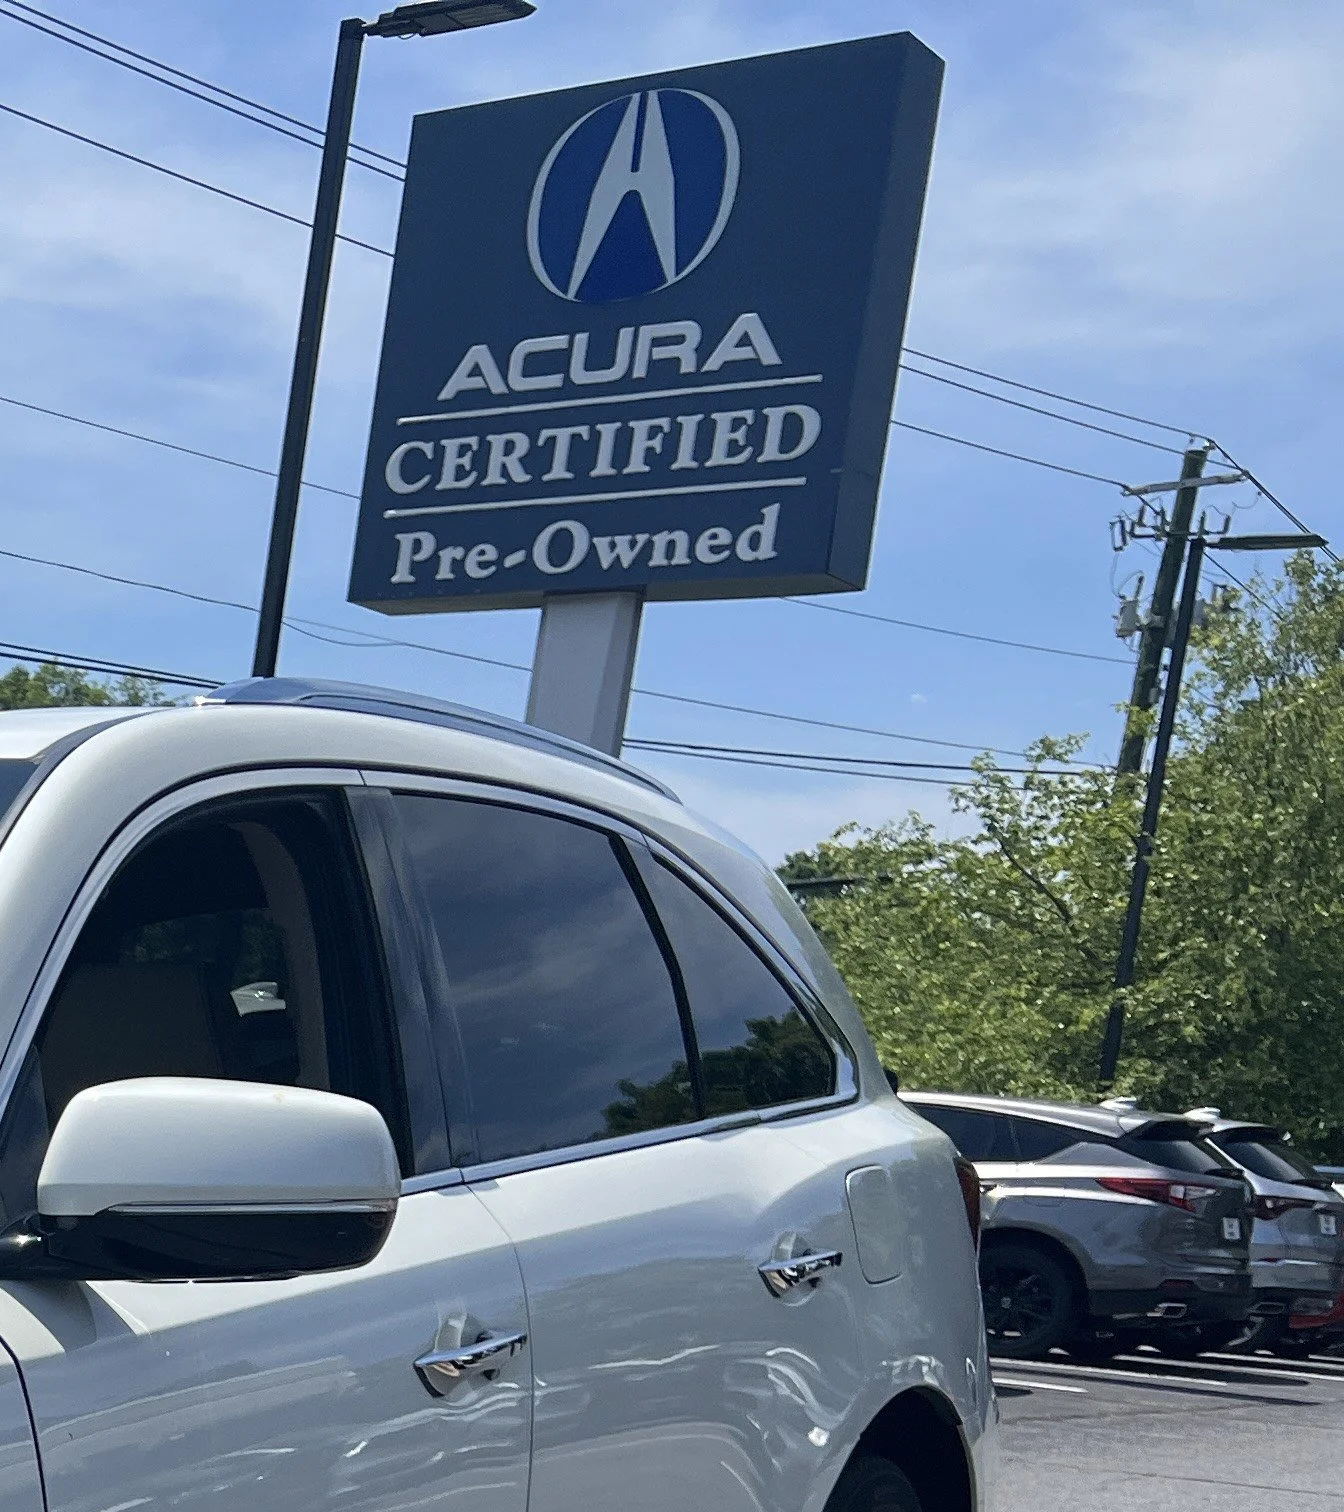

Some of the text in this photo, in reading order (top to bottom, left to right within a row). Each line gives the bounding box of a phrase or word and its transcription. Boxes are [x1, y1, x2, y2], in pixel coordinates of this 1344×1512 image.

[436, 312, 784, 402] ACURA
[384, 403, 823, 495] CERTIFIED
[389, 502, 782, 584] Pre-Owned
